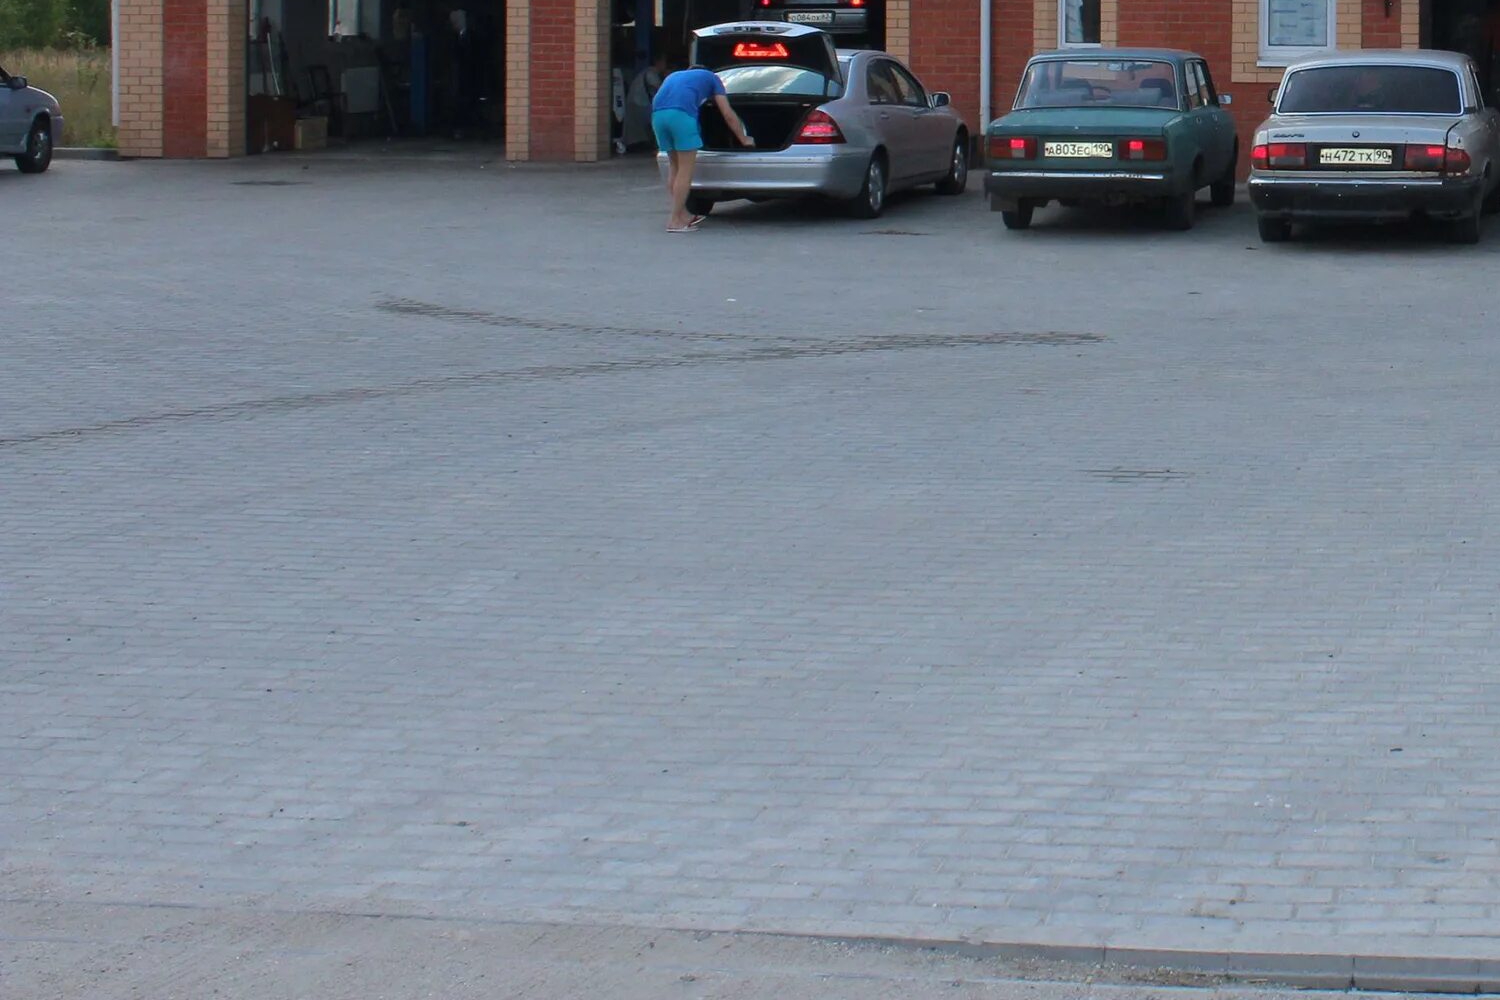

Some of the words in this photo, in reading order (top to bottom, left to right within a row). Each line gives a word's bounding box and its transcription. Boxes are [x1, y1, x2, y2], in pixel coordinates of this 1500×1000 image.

[1048, 143, 1091, 155] А803ЕС
[1093, 143, 1109, 153] 190
[1325, 149, 1372, 162] Н472ТХ
[1375, 150, 1388, 160] 90
